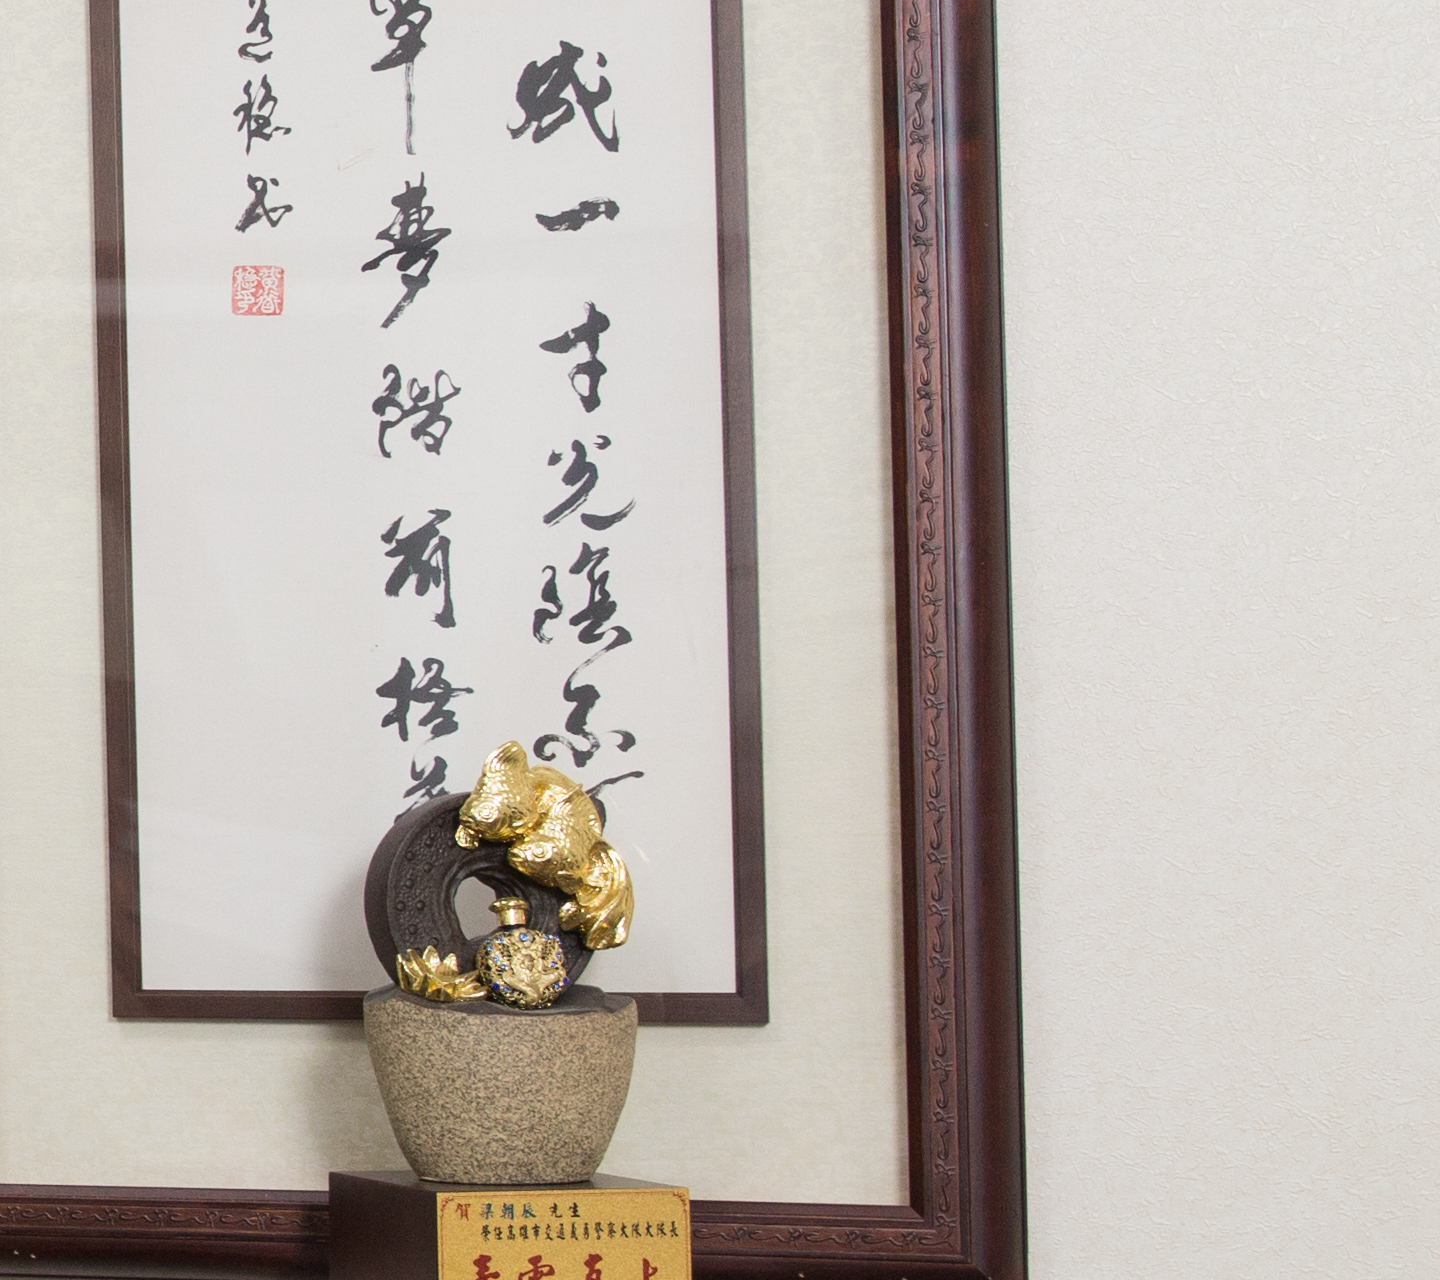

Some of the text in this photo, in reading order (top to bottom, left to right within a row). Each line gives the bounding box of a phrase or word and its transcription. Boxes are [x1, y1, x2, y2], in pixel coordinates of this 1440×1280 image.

[454, 1202, 581, 1220] 賀 梁朝辰 先生
[481, 1221, 679, 1242] 榮任高雄市交通義勇警察大隊大隊長
